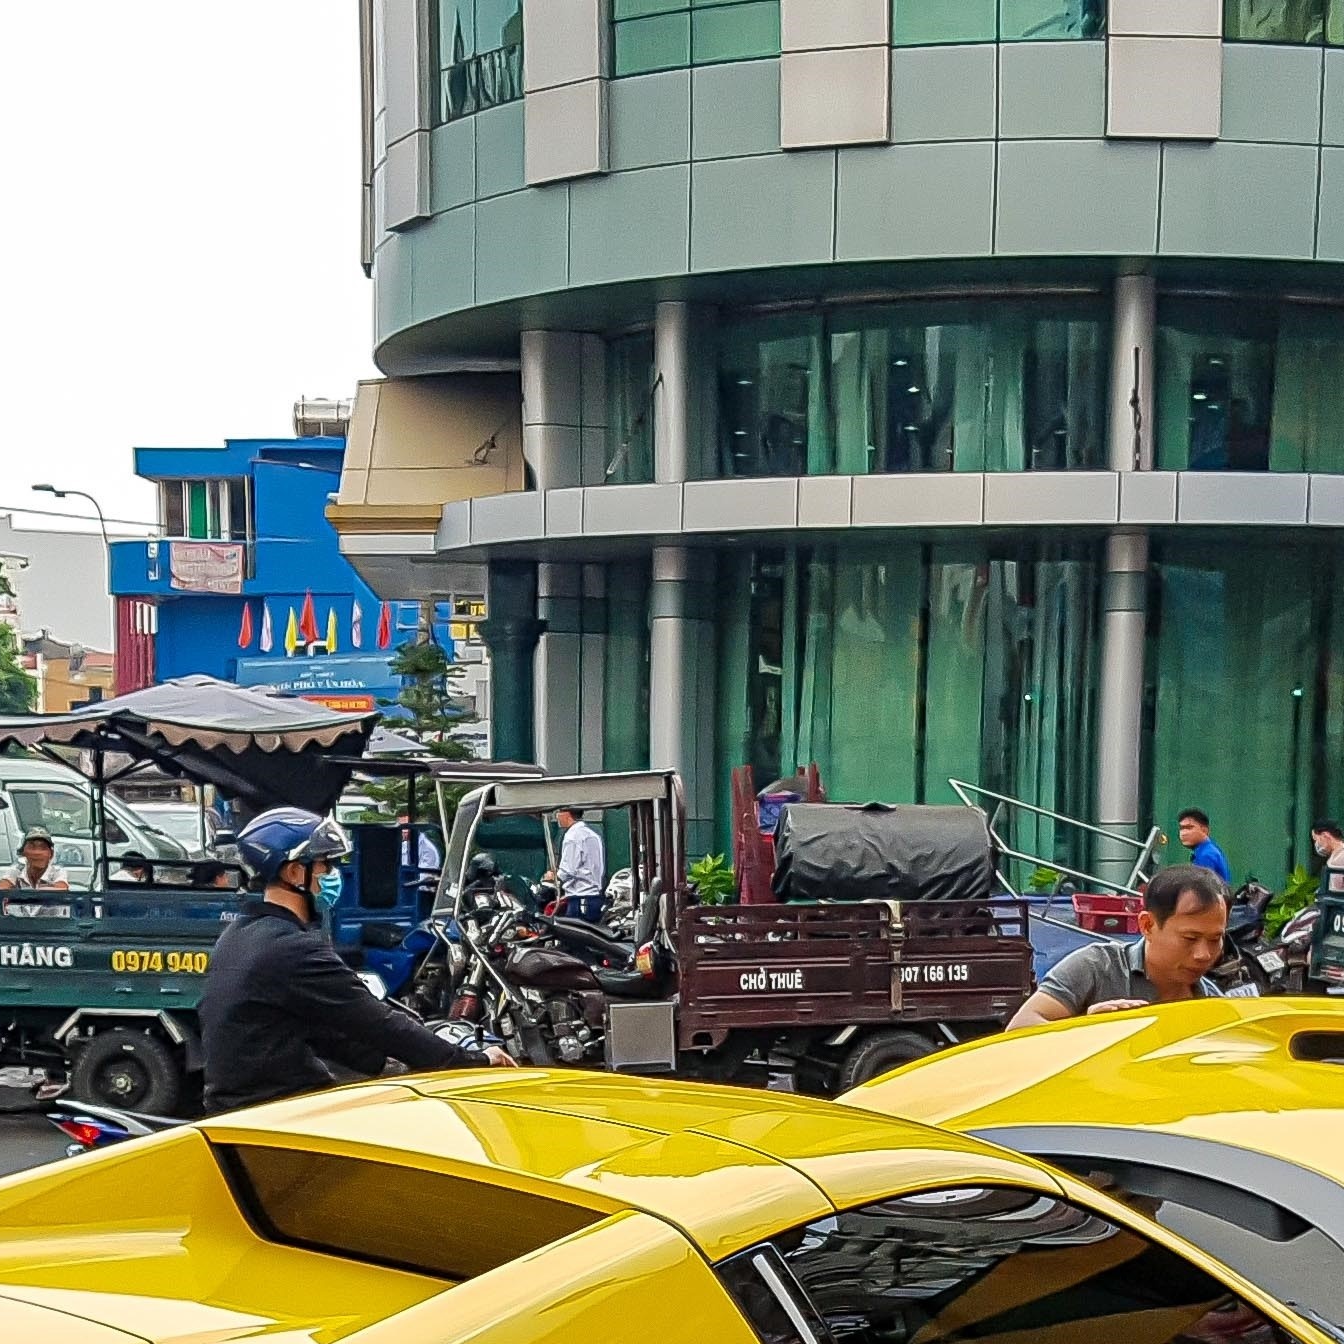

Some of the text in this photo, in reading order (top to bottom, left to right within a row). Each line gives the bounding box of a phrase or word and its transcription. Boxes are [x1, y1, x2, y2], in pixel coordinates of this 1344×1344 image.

[112, 950, 208, 974] 0974 940
[769, 969, 804, 989] THUÊ
[922, 965, 943, 982] 166
[946, 964, 968, 982] 135
